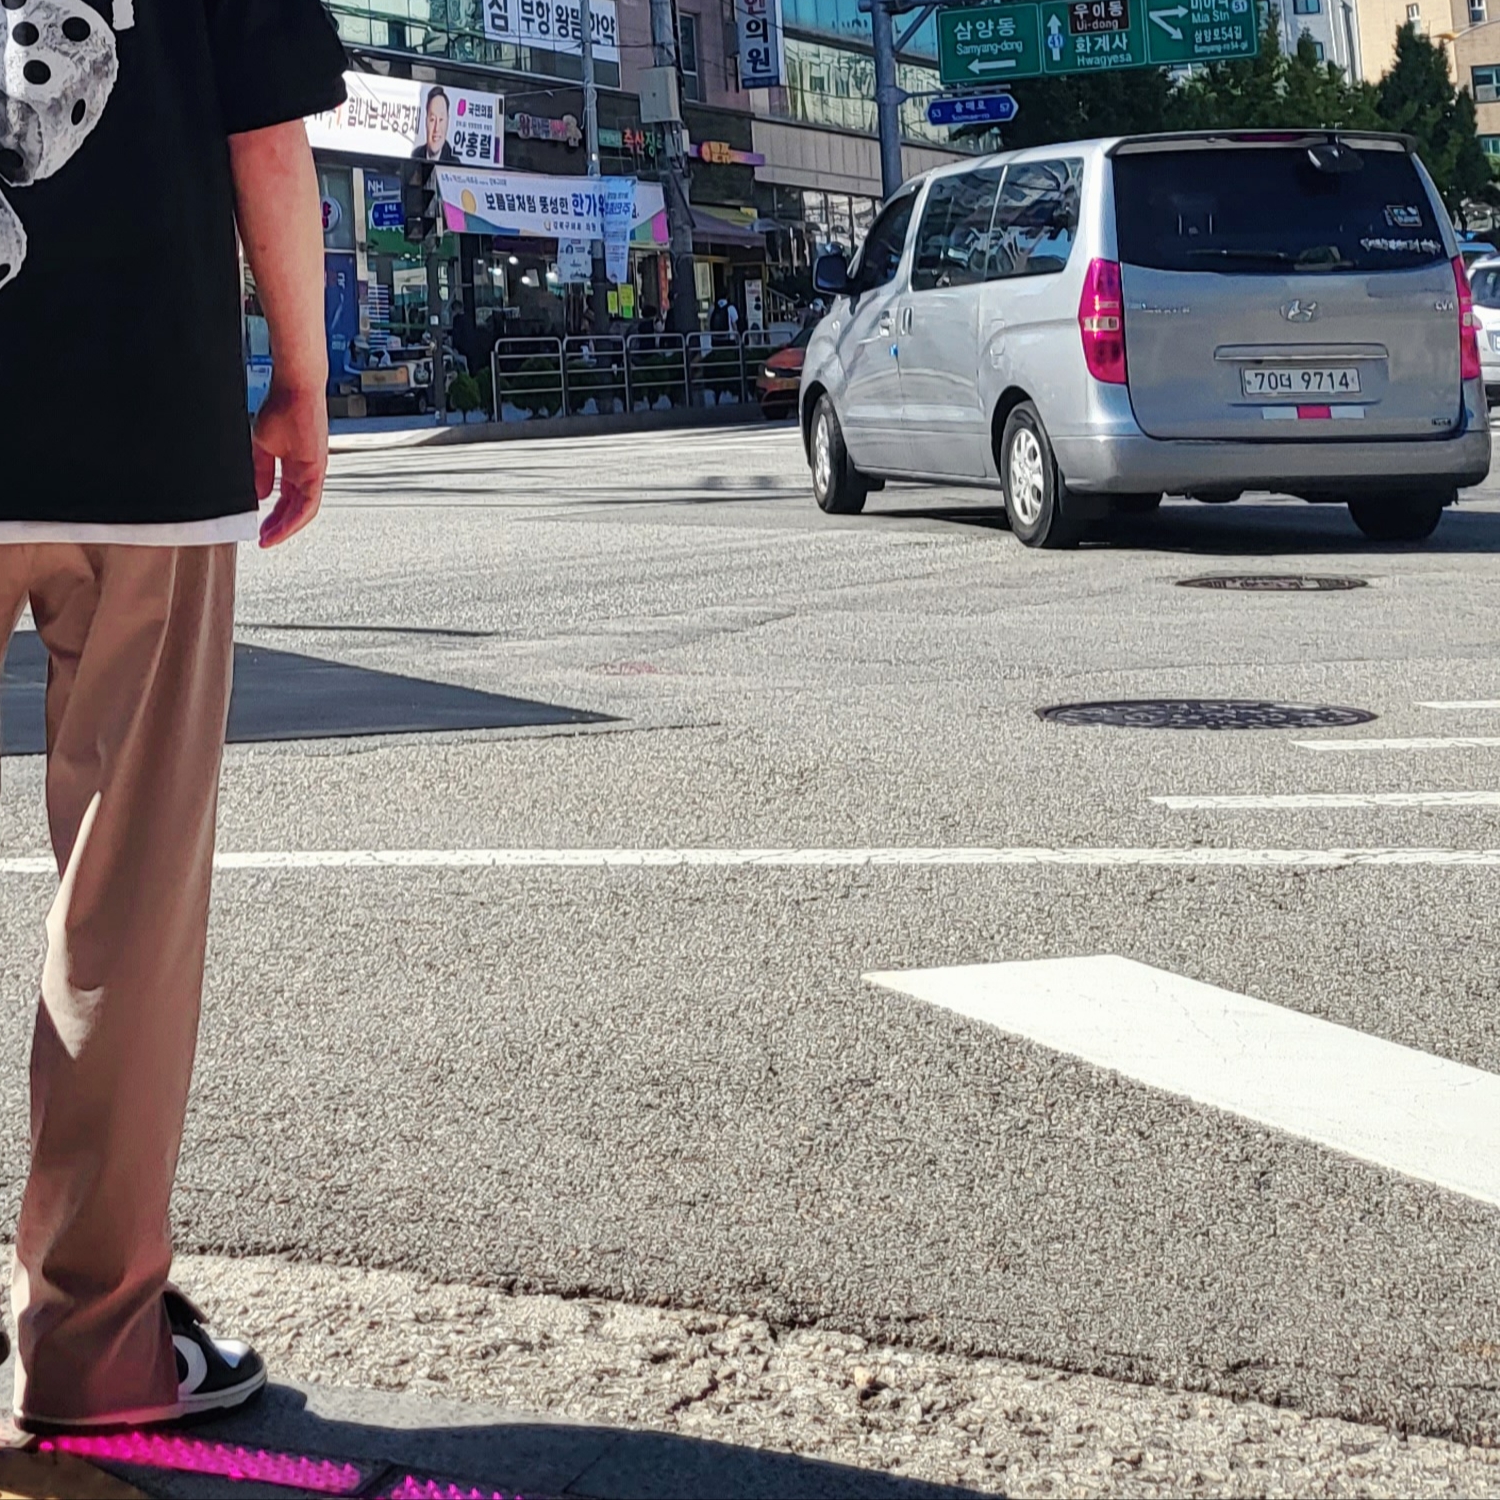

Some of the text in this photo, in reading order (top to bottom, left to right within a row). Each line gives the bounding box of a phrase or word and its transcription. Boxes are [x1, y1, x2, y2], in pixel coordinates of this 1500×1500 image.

[1073, 0, 1124, 20] 우이동
[1191, 11, 1211, 24] Mia
[953, 17, 1017, 42] 삼양동
[1076, 19, 1119, 32] Ui-dong
[956, 39, 1024, 57] Samyang-dong
[1075, 32, 1129, 54] 화계사
[1077, 51, 1133, 68] Hwagyesa
[347, 96, 378, 129] 힘나는
[467, 102, 493, 119] 국민의힘
[999, 102, 1011, 113] 57
[484, 191, 537, 213] 보름달처럼
[539, 195, 570, 216] 풍성한
[1254, 371, 1350, 391] 70더 9714
